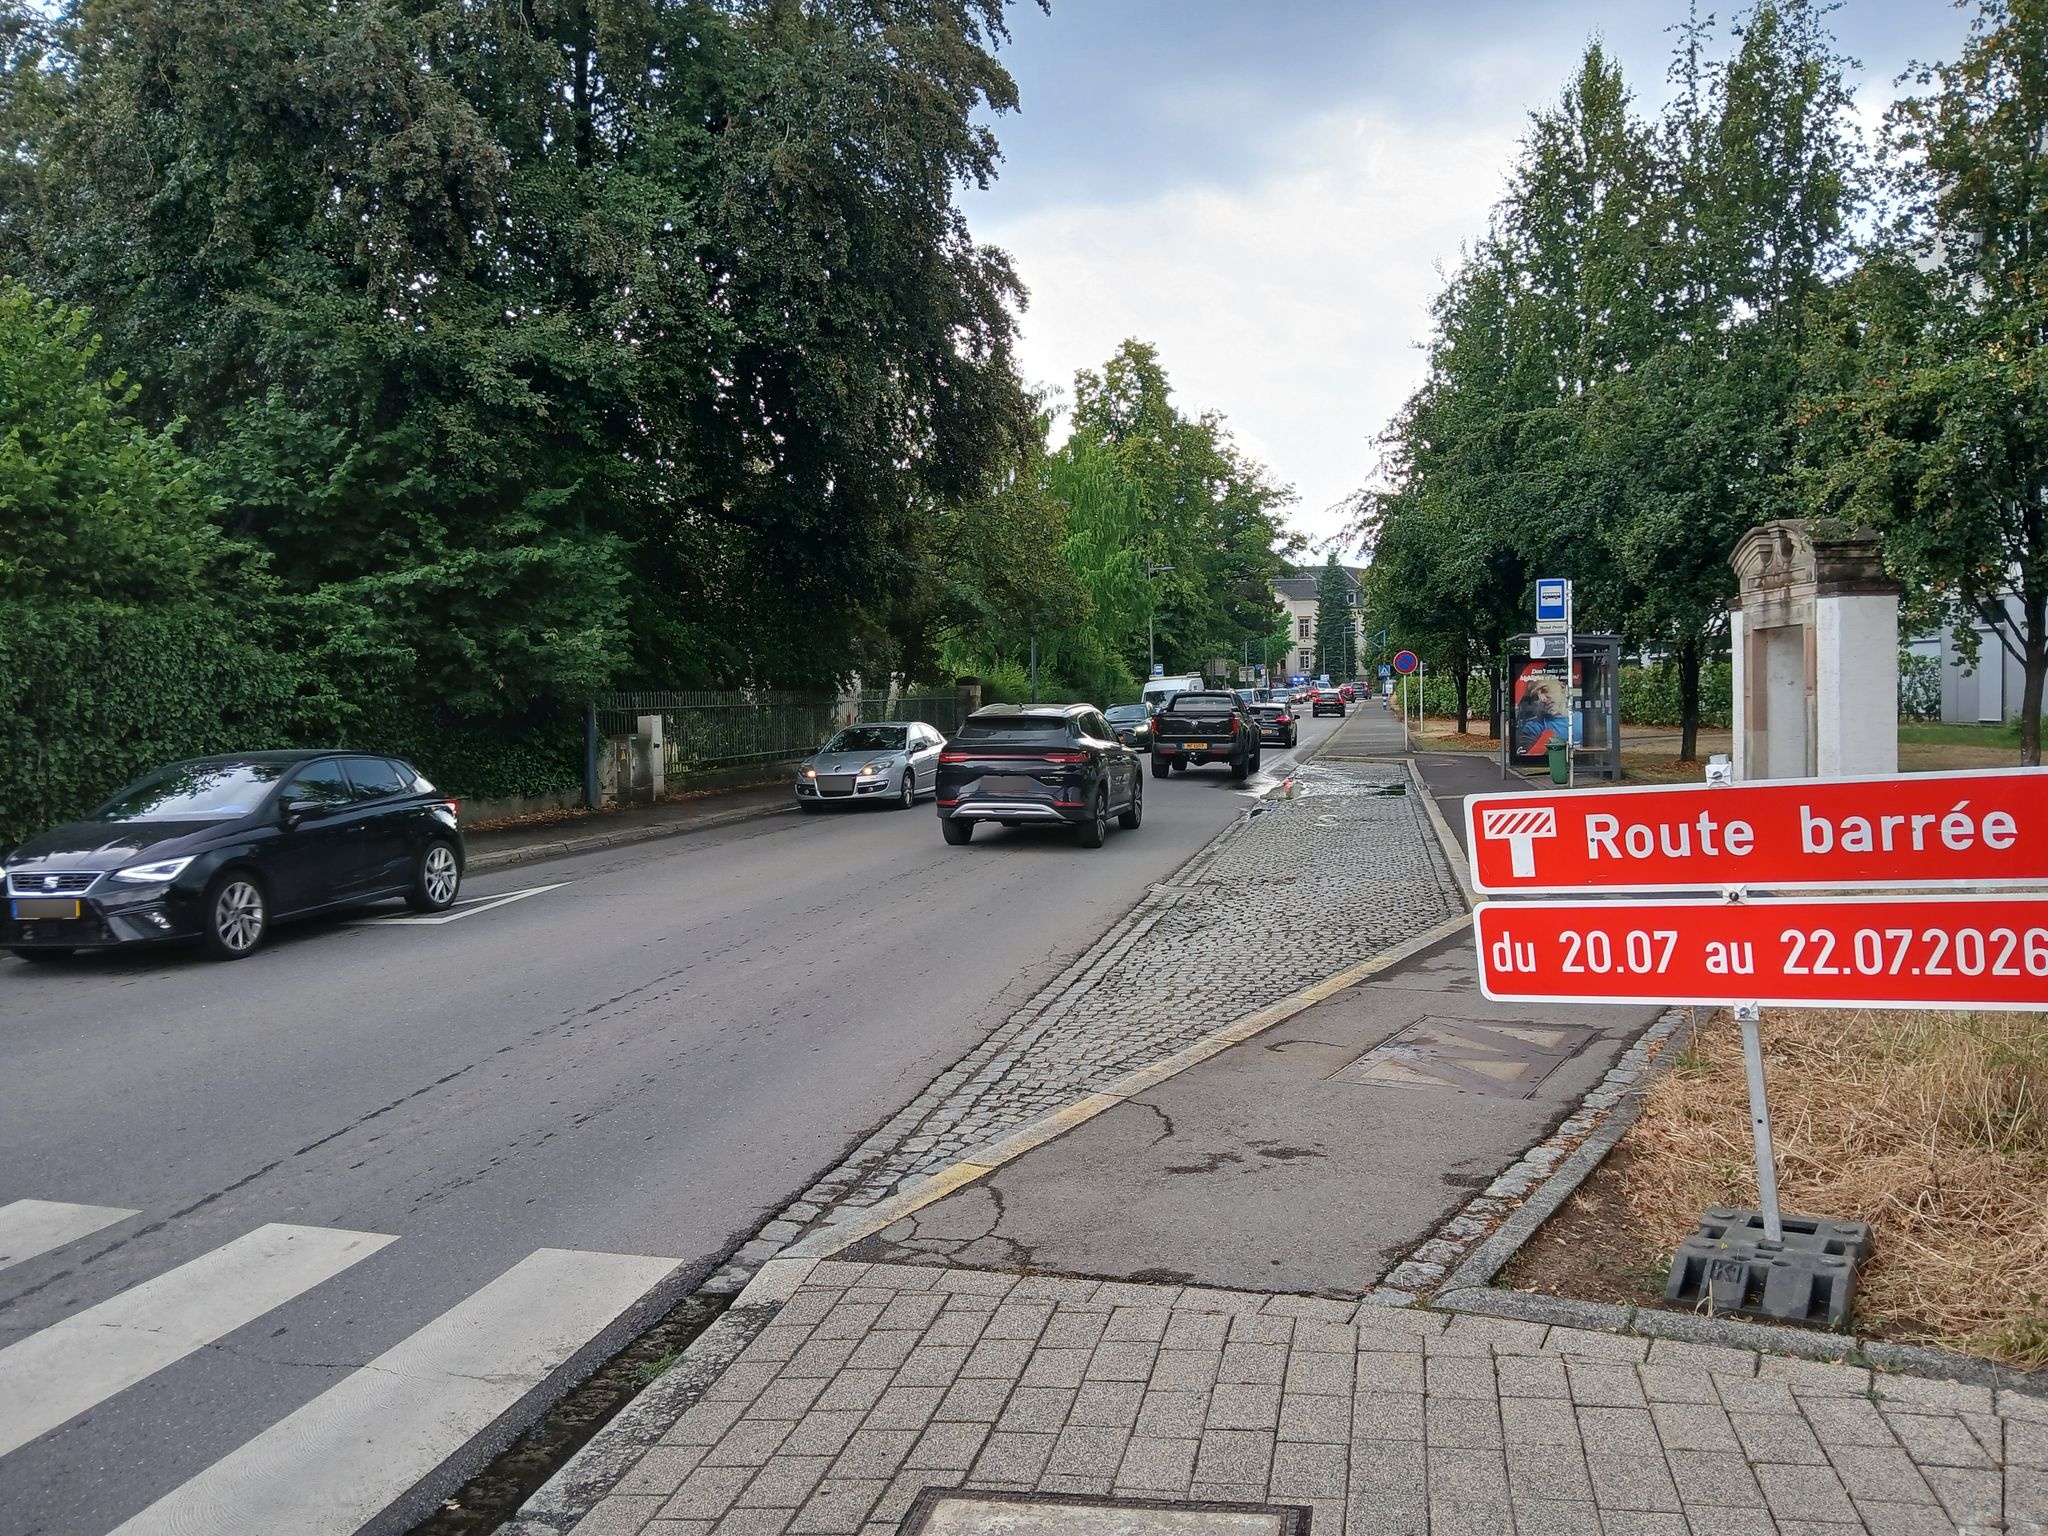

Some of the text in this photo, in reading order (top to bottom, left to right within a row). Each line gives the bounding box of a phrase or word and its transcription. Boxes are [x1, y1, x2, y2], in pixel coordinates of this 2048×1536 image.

[1585, 800, 2019, 860] Route barrée
[1492, 927, 2048, 977] du 20.07 au 22.07.2026
